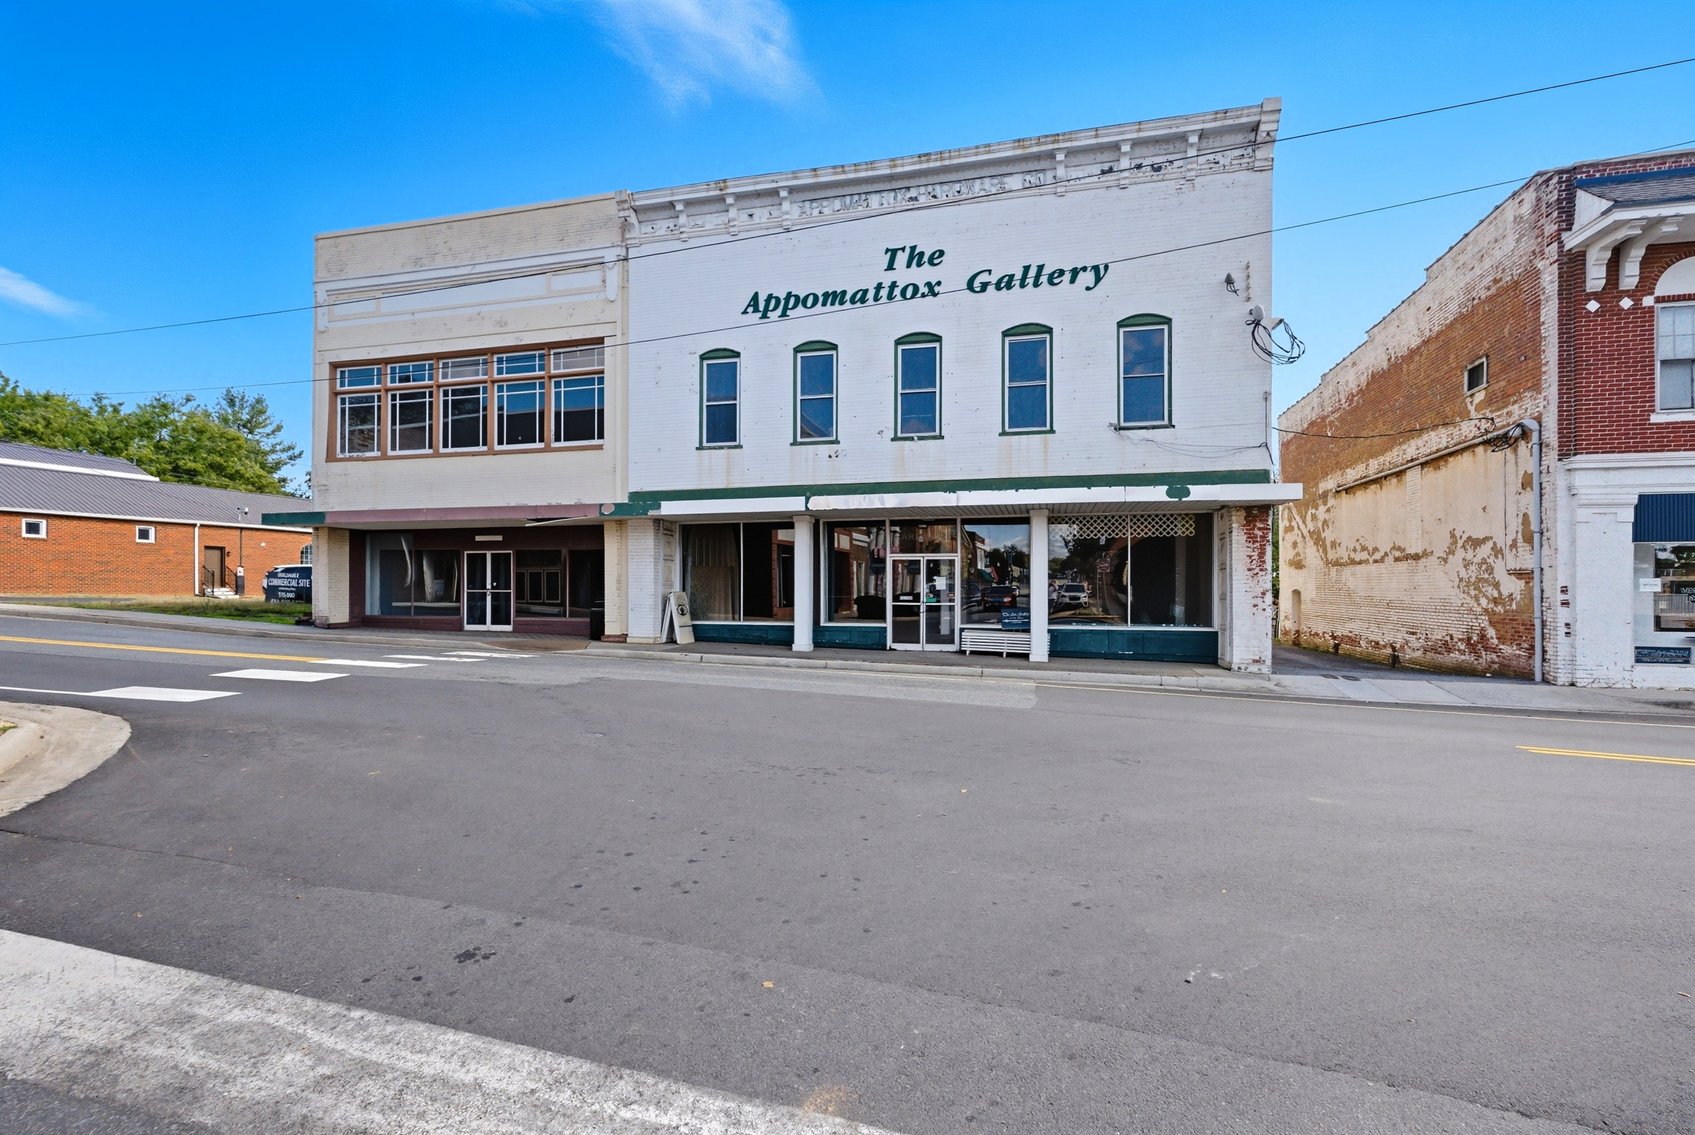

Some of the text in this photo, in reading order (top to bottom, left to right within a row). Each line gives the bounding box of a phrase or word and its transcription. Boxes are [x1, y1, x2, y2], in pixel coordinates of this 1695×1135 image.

[884, 244, 945, 272] The
[741, 263, 1110, 319] Appomattox Gallery
[268, 578, 298, 586] COMMERCIAL
